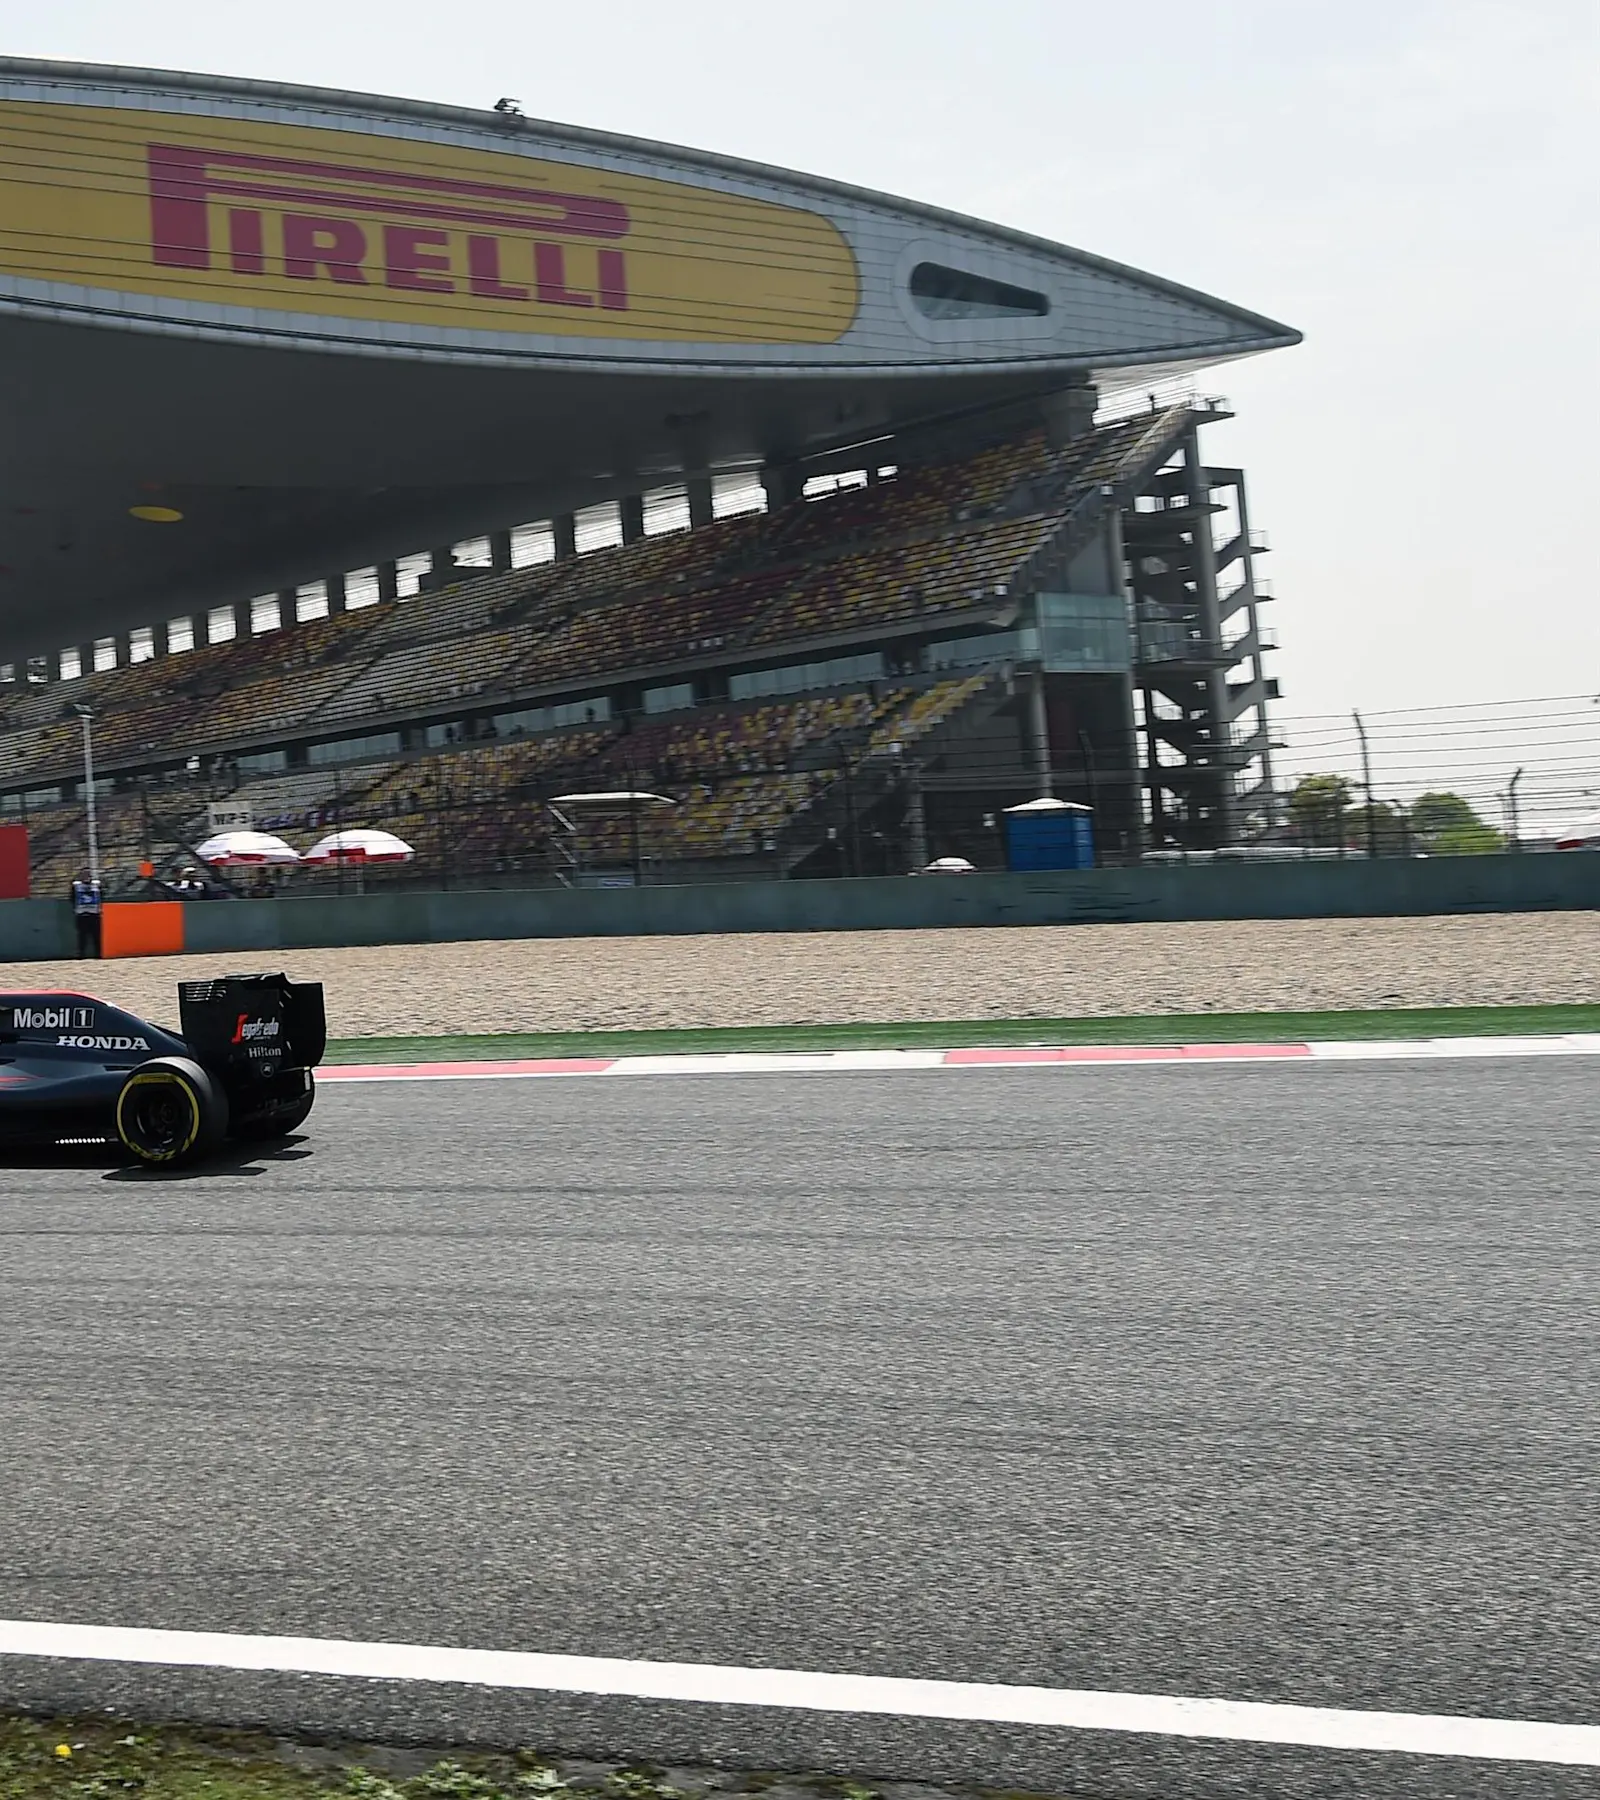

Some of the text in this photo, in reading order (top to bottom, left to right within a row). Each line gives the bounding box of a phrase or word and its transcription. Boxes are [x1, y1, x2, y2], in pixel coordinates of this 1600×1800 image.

[147, 141, 630, 310] PIRELLI
[13, 1007, 70, 1028] Mobil
[56, 1035, 151, 1050] HONDA
[248, 1046, 282, 1058] Hilton
